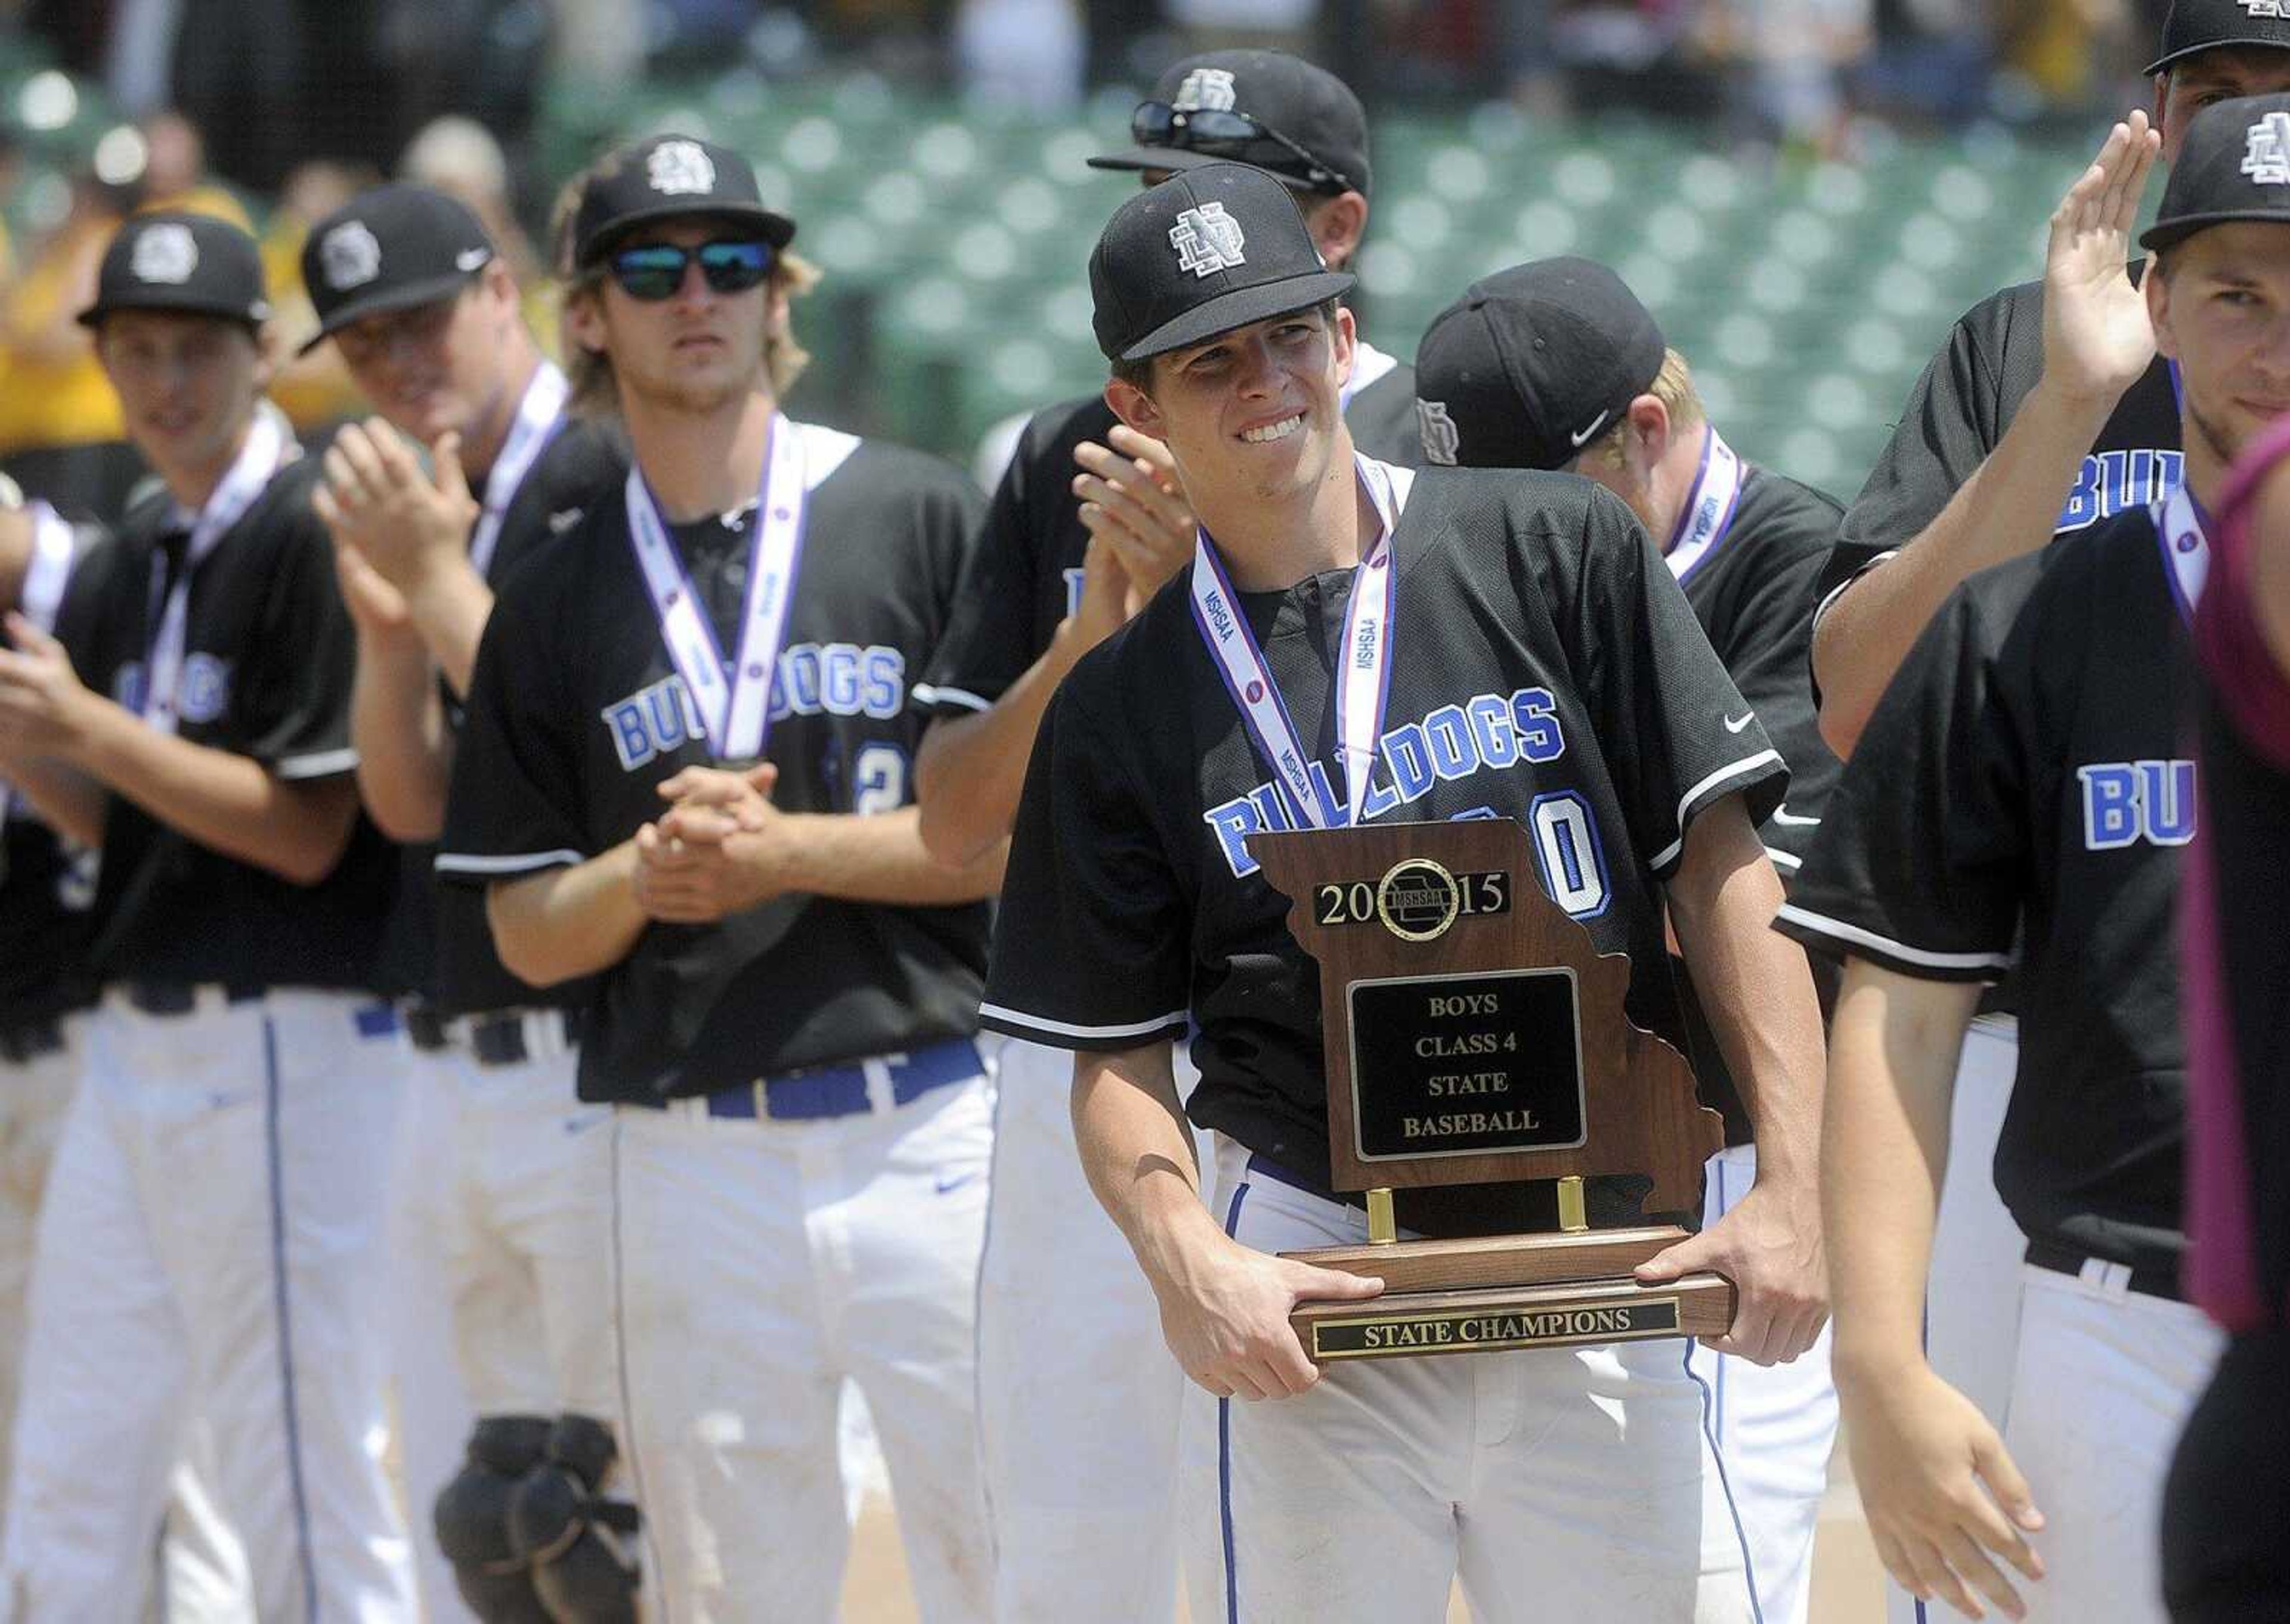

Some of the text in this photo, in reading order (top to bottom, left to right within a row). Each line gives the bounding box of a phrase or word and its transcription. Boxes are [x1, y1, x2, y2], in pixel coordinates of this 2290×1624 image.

[1203, 590, 1235, 644] MSHSAA
[1356, 618, 1376, 670] MSHSAA
[1280, 749, 1310, 802] MSHSAA
[1321, 874, 1503, 924] 20 15
[1395, 891, 1442, 906] MSHSAA
[1429, 994, 1499, 1018] BOYS
[1416, 1034, 1517, 1057] CLASS 4
[1428, 1073, 1509, 1097] STATE
[1403, 1111, 1539, 1138] BASEBALL
[1364, 1308, 1631, 1348] STATE CHAMPIONS
